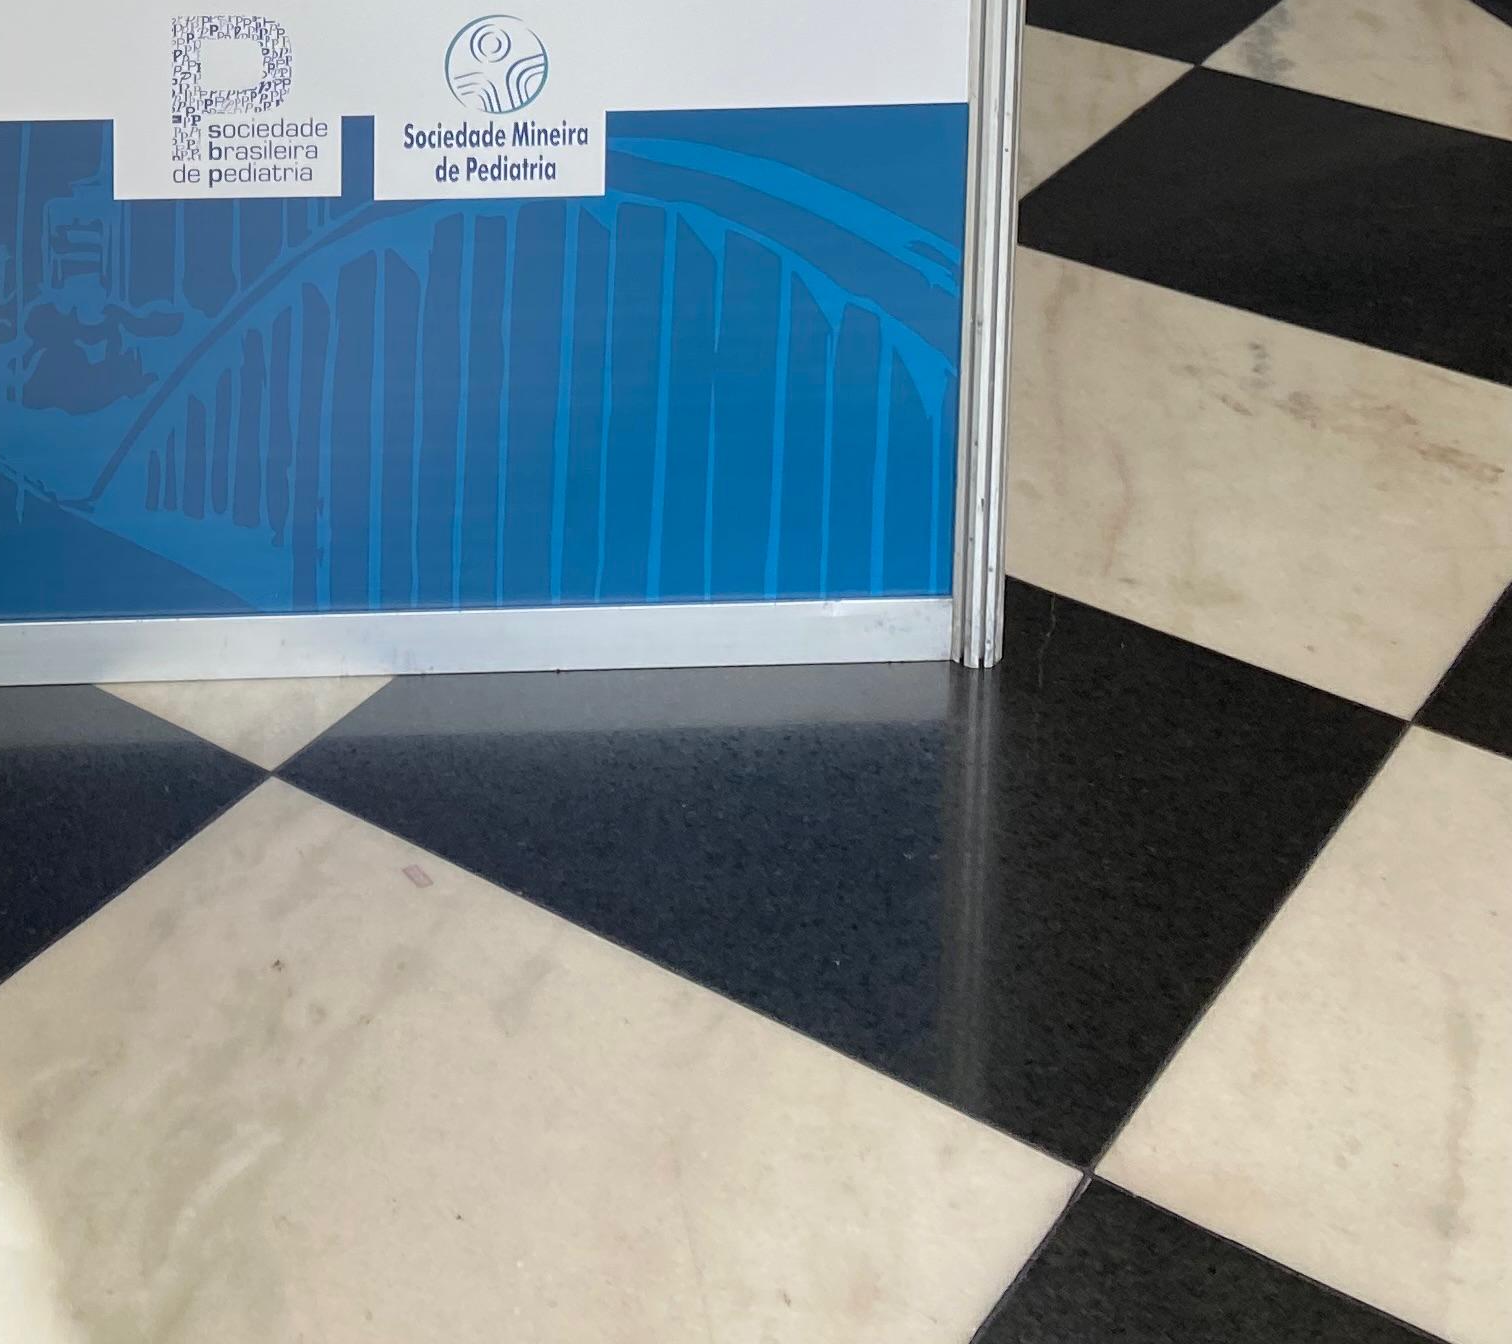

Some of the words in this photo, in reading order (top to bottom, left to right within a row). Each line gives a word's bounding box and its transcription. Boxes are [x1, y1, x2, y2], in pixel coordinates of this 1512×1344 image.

[207, 117, 329, 139] sociedade
[403, 122, 506, 150] Sociedade
[511, 120, 590, 148] Mineira
[207, 140, 319, 162] brasileira
[172, 163, 201, 184] de
[207, 162, 314, 189] pediatria
[435, 155, 461, 183] de
[466, 154, 558, 183] Pediatria
